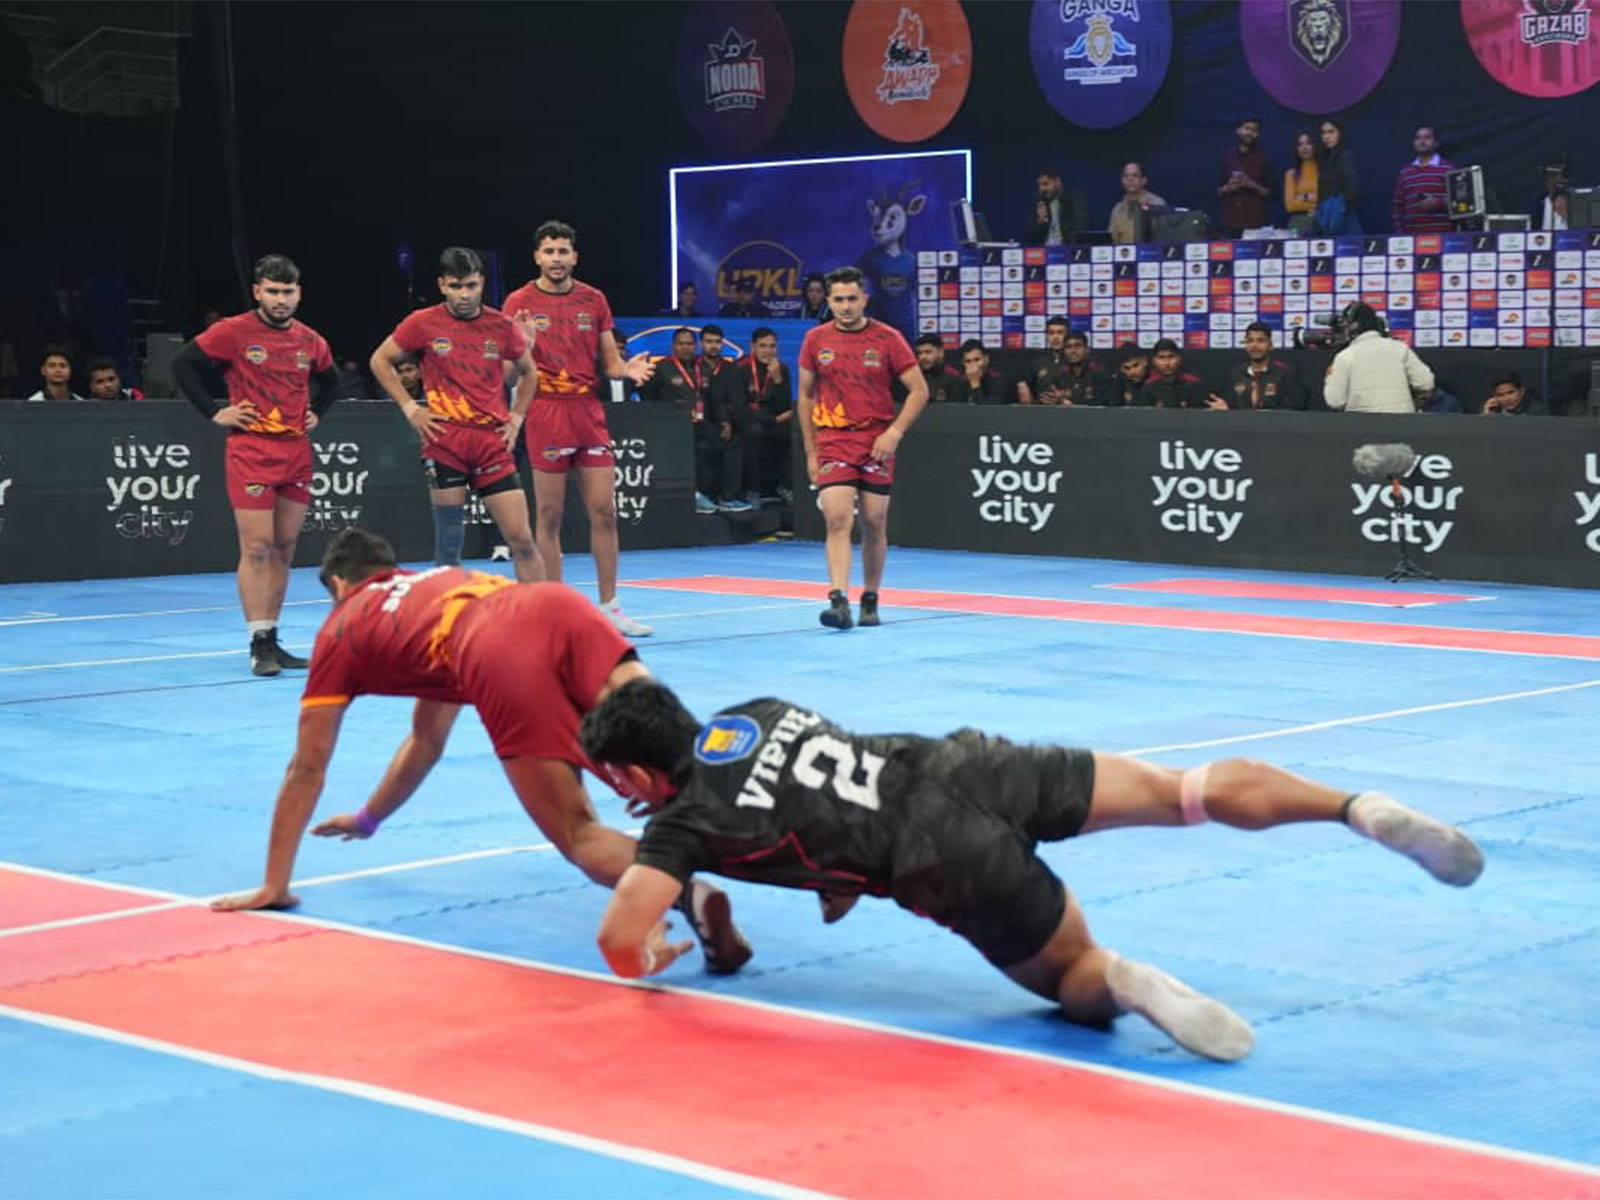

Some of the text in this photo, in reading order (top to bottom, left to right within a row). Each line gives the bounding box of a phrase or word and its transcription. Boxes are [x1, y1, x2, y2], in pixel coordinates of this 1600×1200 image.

[1062, 0, 1138, 20] GANGA
[1524, 13, 1586, 39] GAZAB
[709, 62, 762, 95] NOIDA
[112, 434, 192, 470] live
[312, 442, 360, 466] ve
[979, 434, 1054, 465] live
[1160, 440, 1243, 473] live
[308, 470, 370, 497] our
[613, 463, 655, 488] our
[970, 468, 1064, 499] your
[1150, 474, 1254, 507] your
[106, 474, 202, 512] your
[1350, 482, 1465, 516] your
[114, 503, 195, 548] city
[979, 493, 1056, 533] city
[1160, 501, 1245, 543] city
[1360, 511, 1455, 554] city
[791, 733, 887, 812] 2
